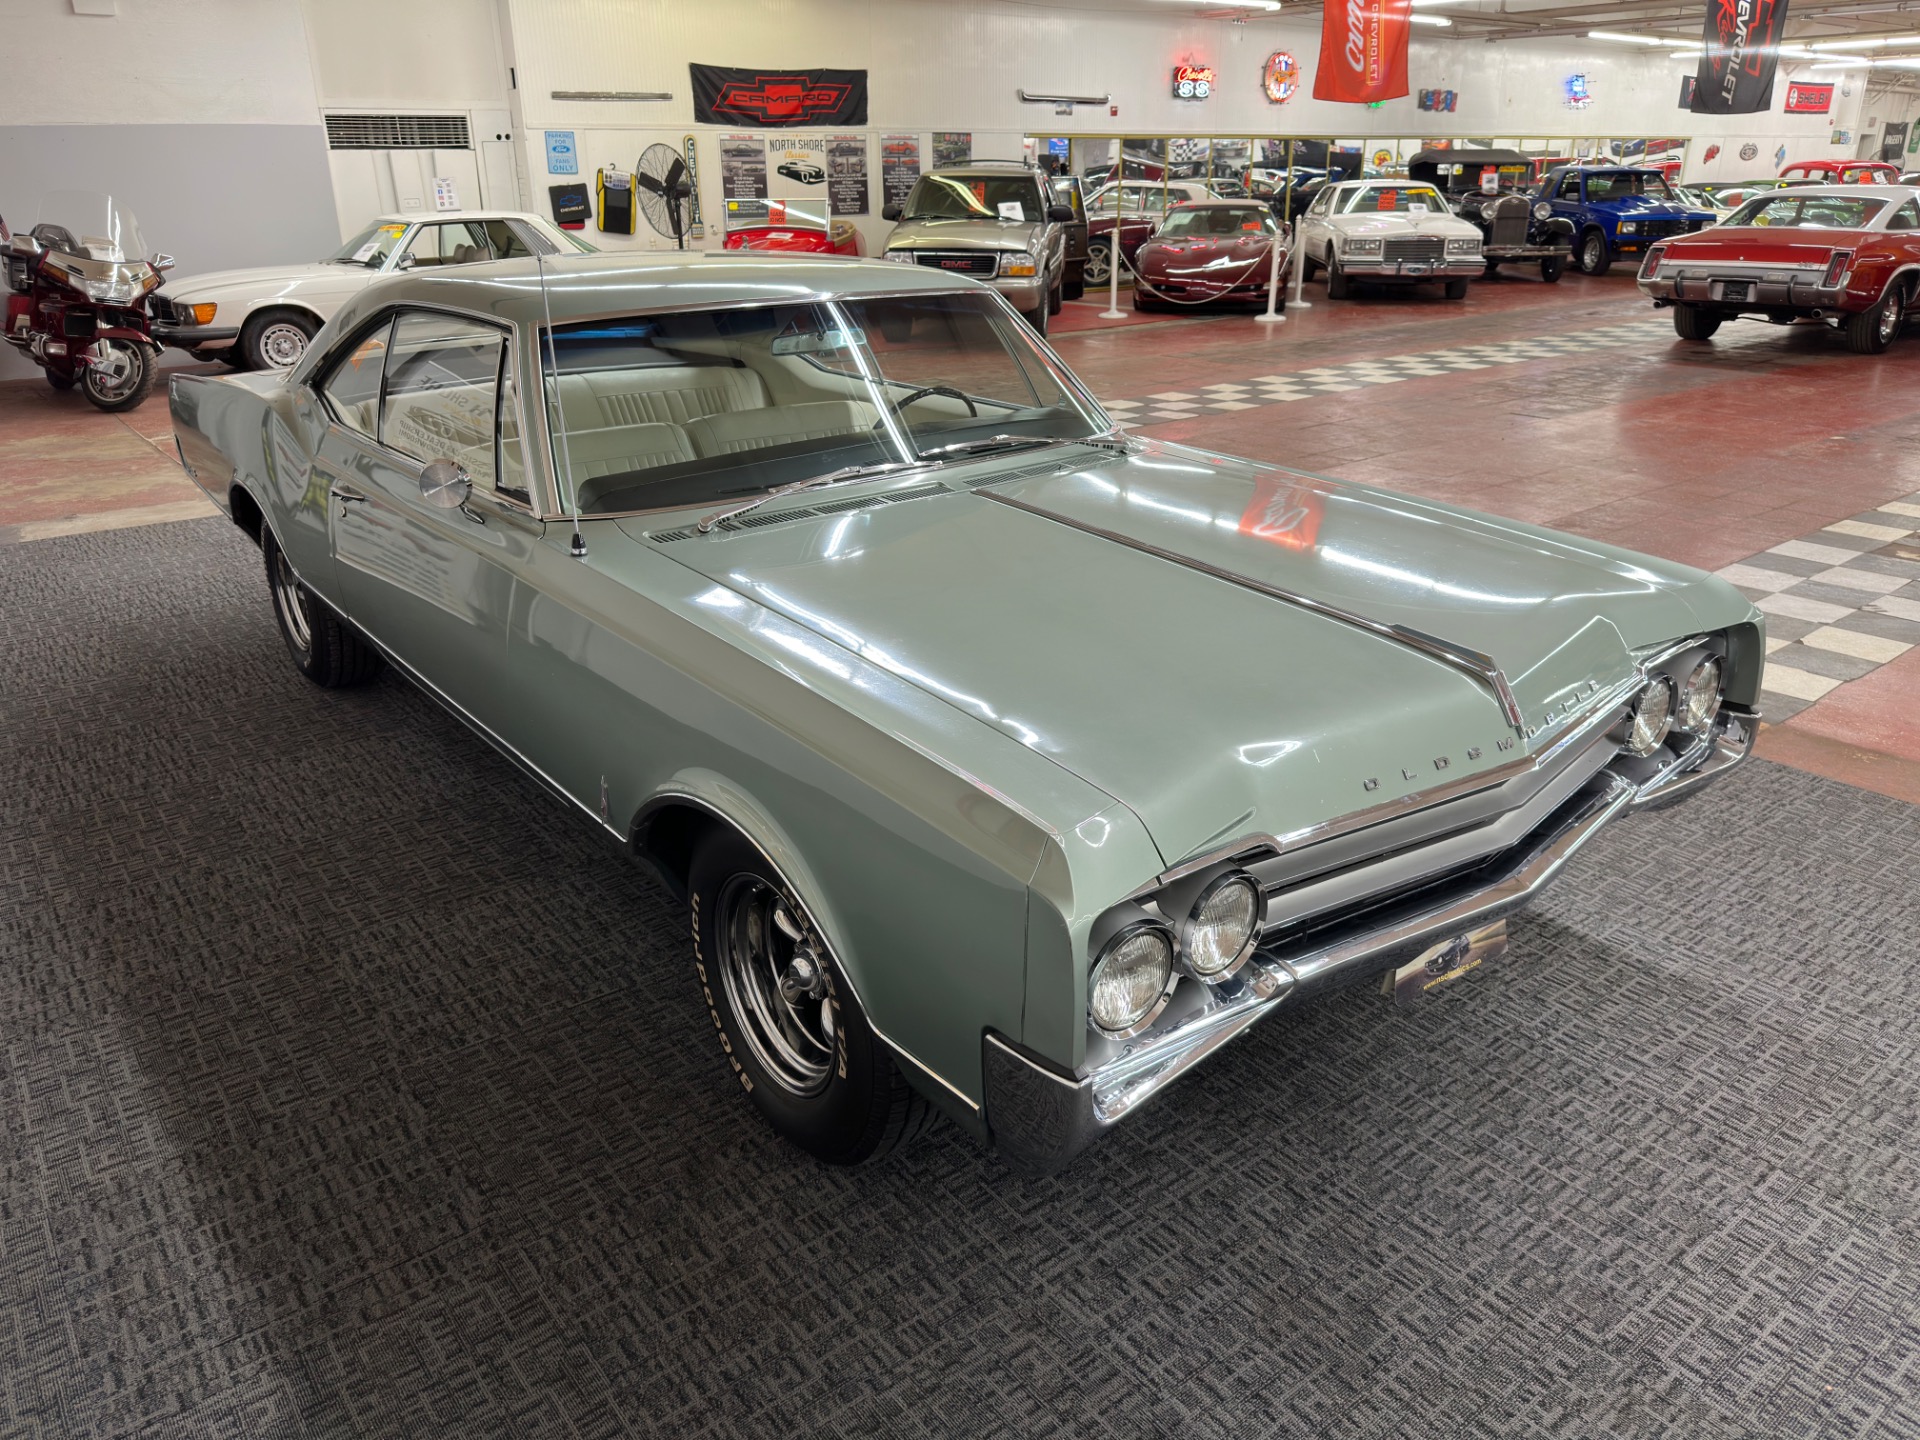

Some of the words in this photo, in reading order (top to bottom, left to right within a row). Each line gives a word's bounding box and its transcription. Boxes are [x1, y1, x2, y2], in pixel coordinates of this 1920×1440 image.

[1370, 4, 1379, 80] CHEVROLET
[1721, 0, 1752, 105] EVROLET
[1178, 80, 1210, 98] SS
[733, 93, 832, 105] CAMARO
[1798, 92, 1830, 104] SHELBY
[769, 139, 796, 152] NORTH
[798, 140, 825, 153] SHORE
[784, 150, 810, 159] Classics
[559, 205, 585, 213] CHEVROLET
[940, 260, 972, 269] GMC
[835, 1026, 848, 1080] T/A
